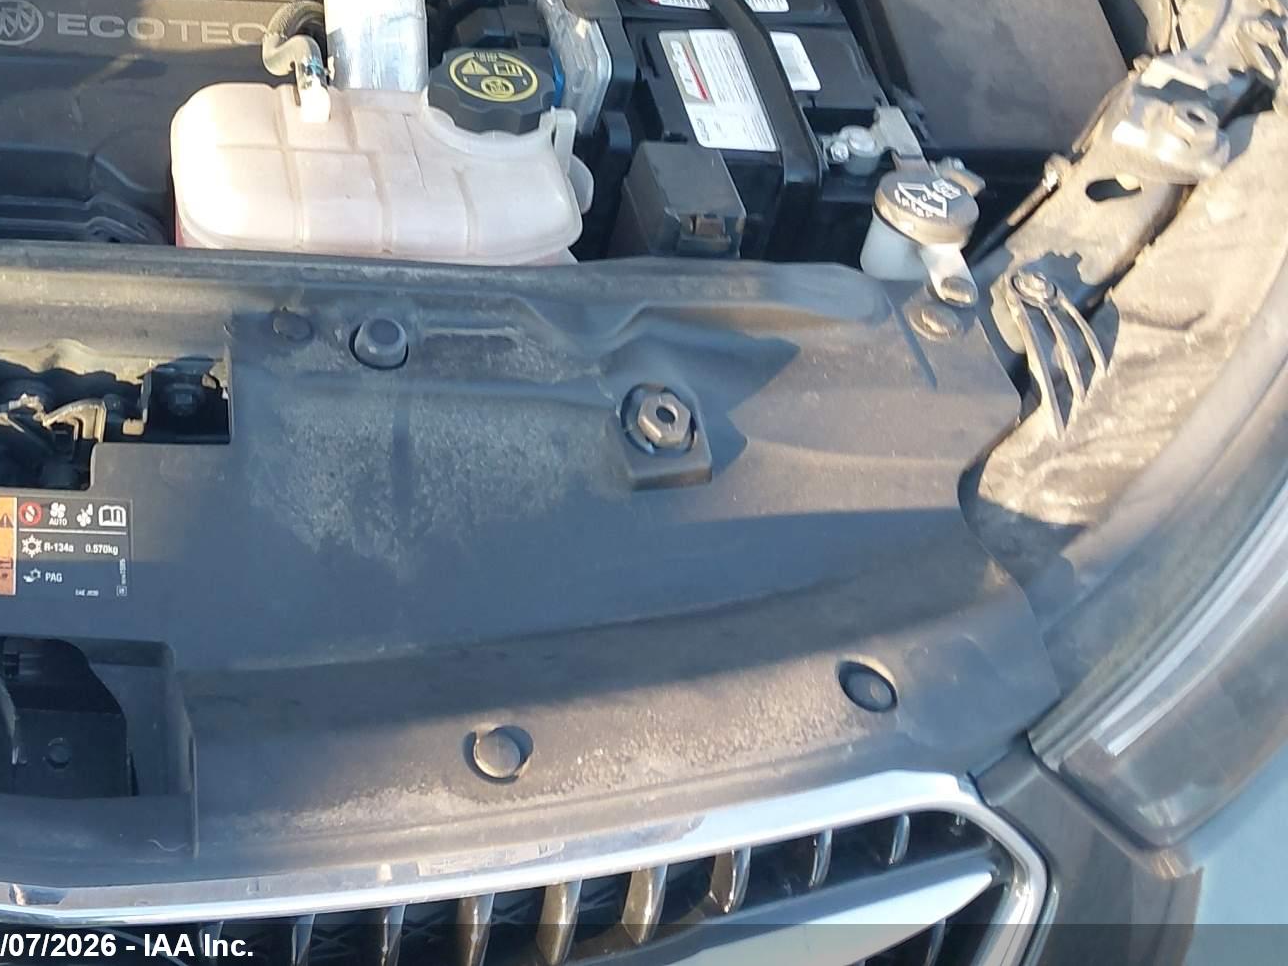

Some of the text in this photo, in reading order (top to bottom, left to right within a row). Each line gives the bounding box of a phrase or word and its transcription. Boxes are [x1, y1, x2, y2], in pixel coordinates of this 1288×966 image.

[57, 14, 267, 45] ECOTEC
[48, 517, 68, 526] AUTO
[44, 543, 119, 556] R-134a 0.570kg
[45, 572, 63, 583] PAG
